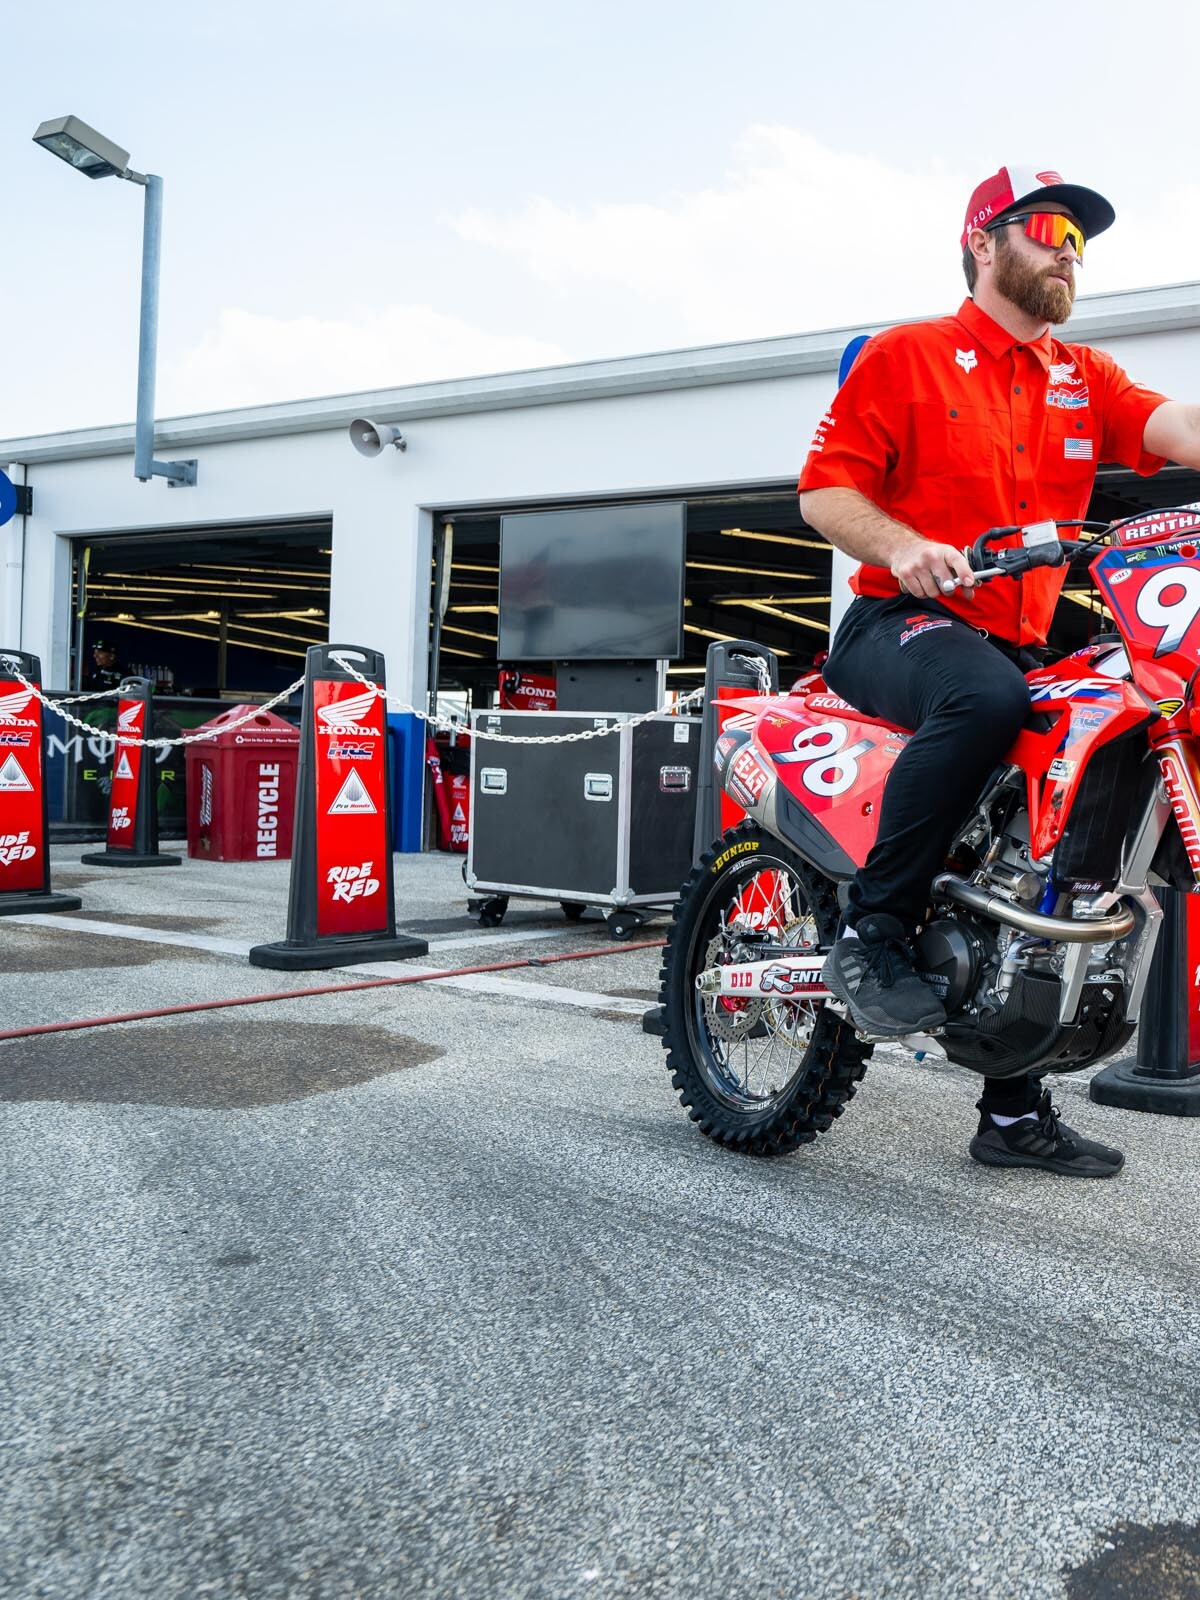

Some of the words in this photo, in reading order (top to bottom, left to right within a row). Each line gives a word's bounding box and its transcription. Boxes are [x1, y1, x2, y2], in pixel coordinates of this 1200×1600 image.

[973, 204, 993, 227] FOX
[516, 685, 558, 699] HOND
[1028, 677, 1124, 703] RF
[0, 718, 38, 727] ONDA
[318, 725, 381, 736] HONDA
[327, 741, 375, 757] HRC
[771, 720, 876, 798] 96
[257, 763, 280, 857] RECYCLE
[112, 817, 131, 831] RED
[0, 831, 30, 848] IDE
[715, 841, 760, 870] DUNLOP
[327, 861, 374, 883] RIDE
[332, 878, 380, 904] RED
[731, 972, 752, 988] DID
